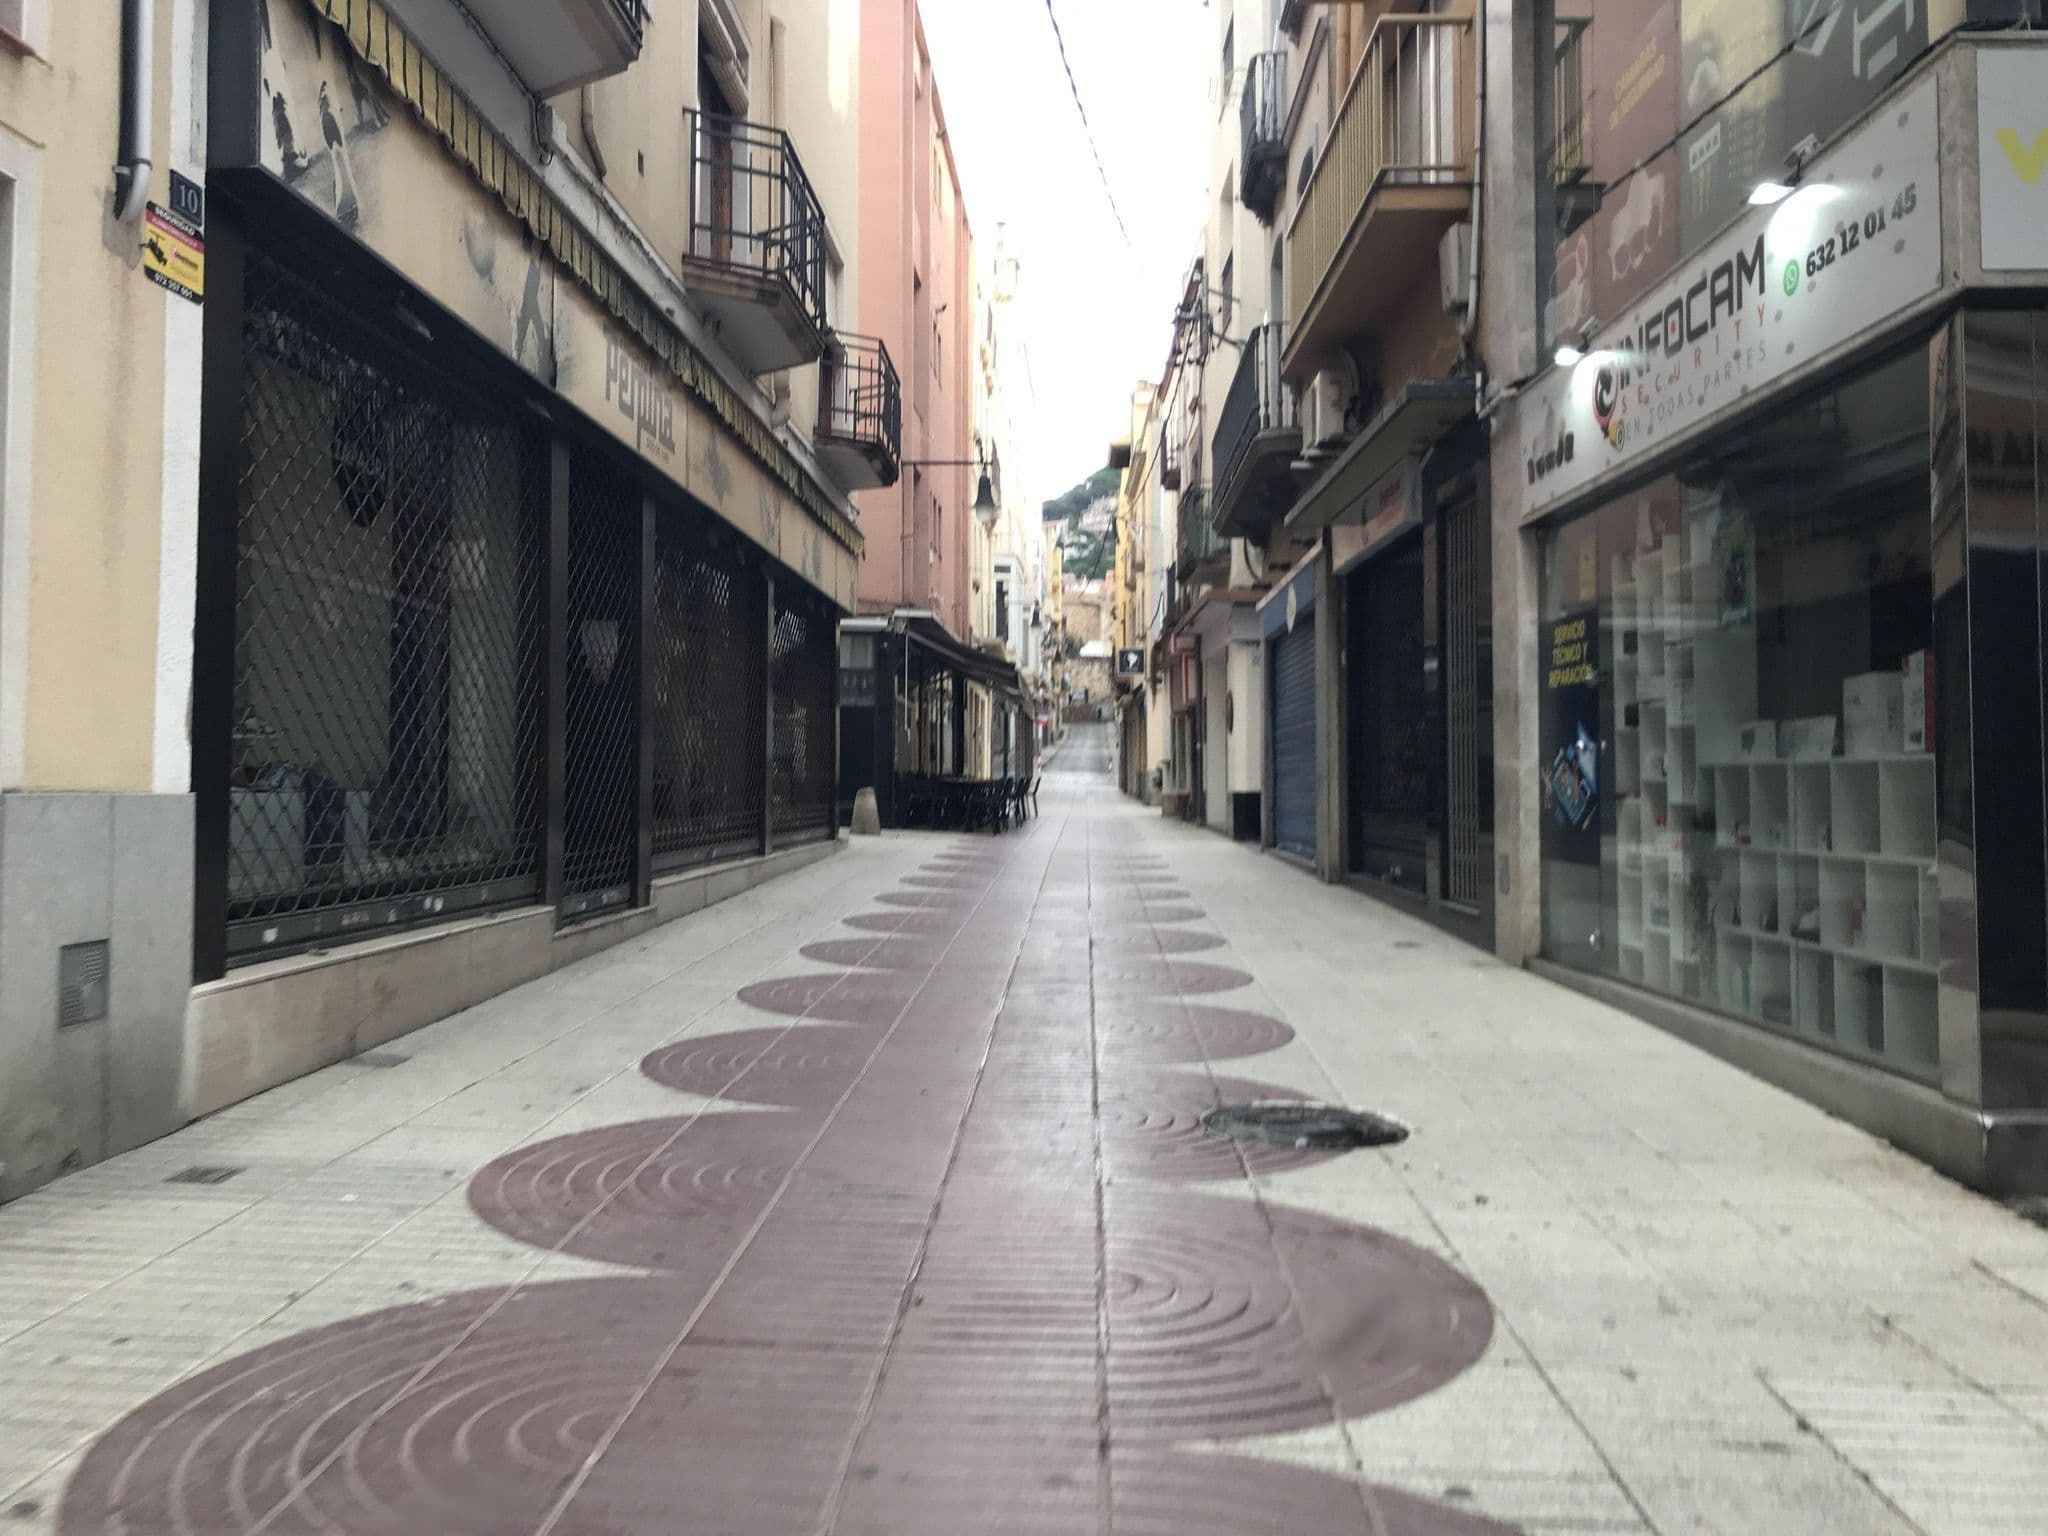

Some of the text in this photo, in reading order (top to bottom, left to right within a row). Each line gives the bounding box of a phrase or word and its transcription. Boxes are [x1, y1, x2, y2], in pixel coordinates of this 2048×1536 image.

[180, 184, 198, 215] 10
[1806, 182, 1917, 277] 632 12 01 45
[1619, 232, 1766, 390] INFOCAM
[1620, 302, 1767, 414] SECURITY
[1625, 339, 1767, 441] EN TODAS PARTES
